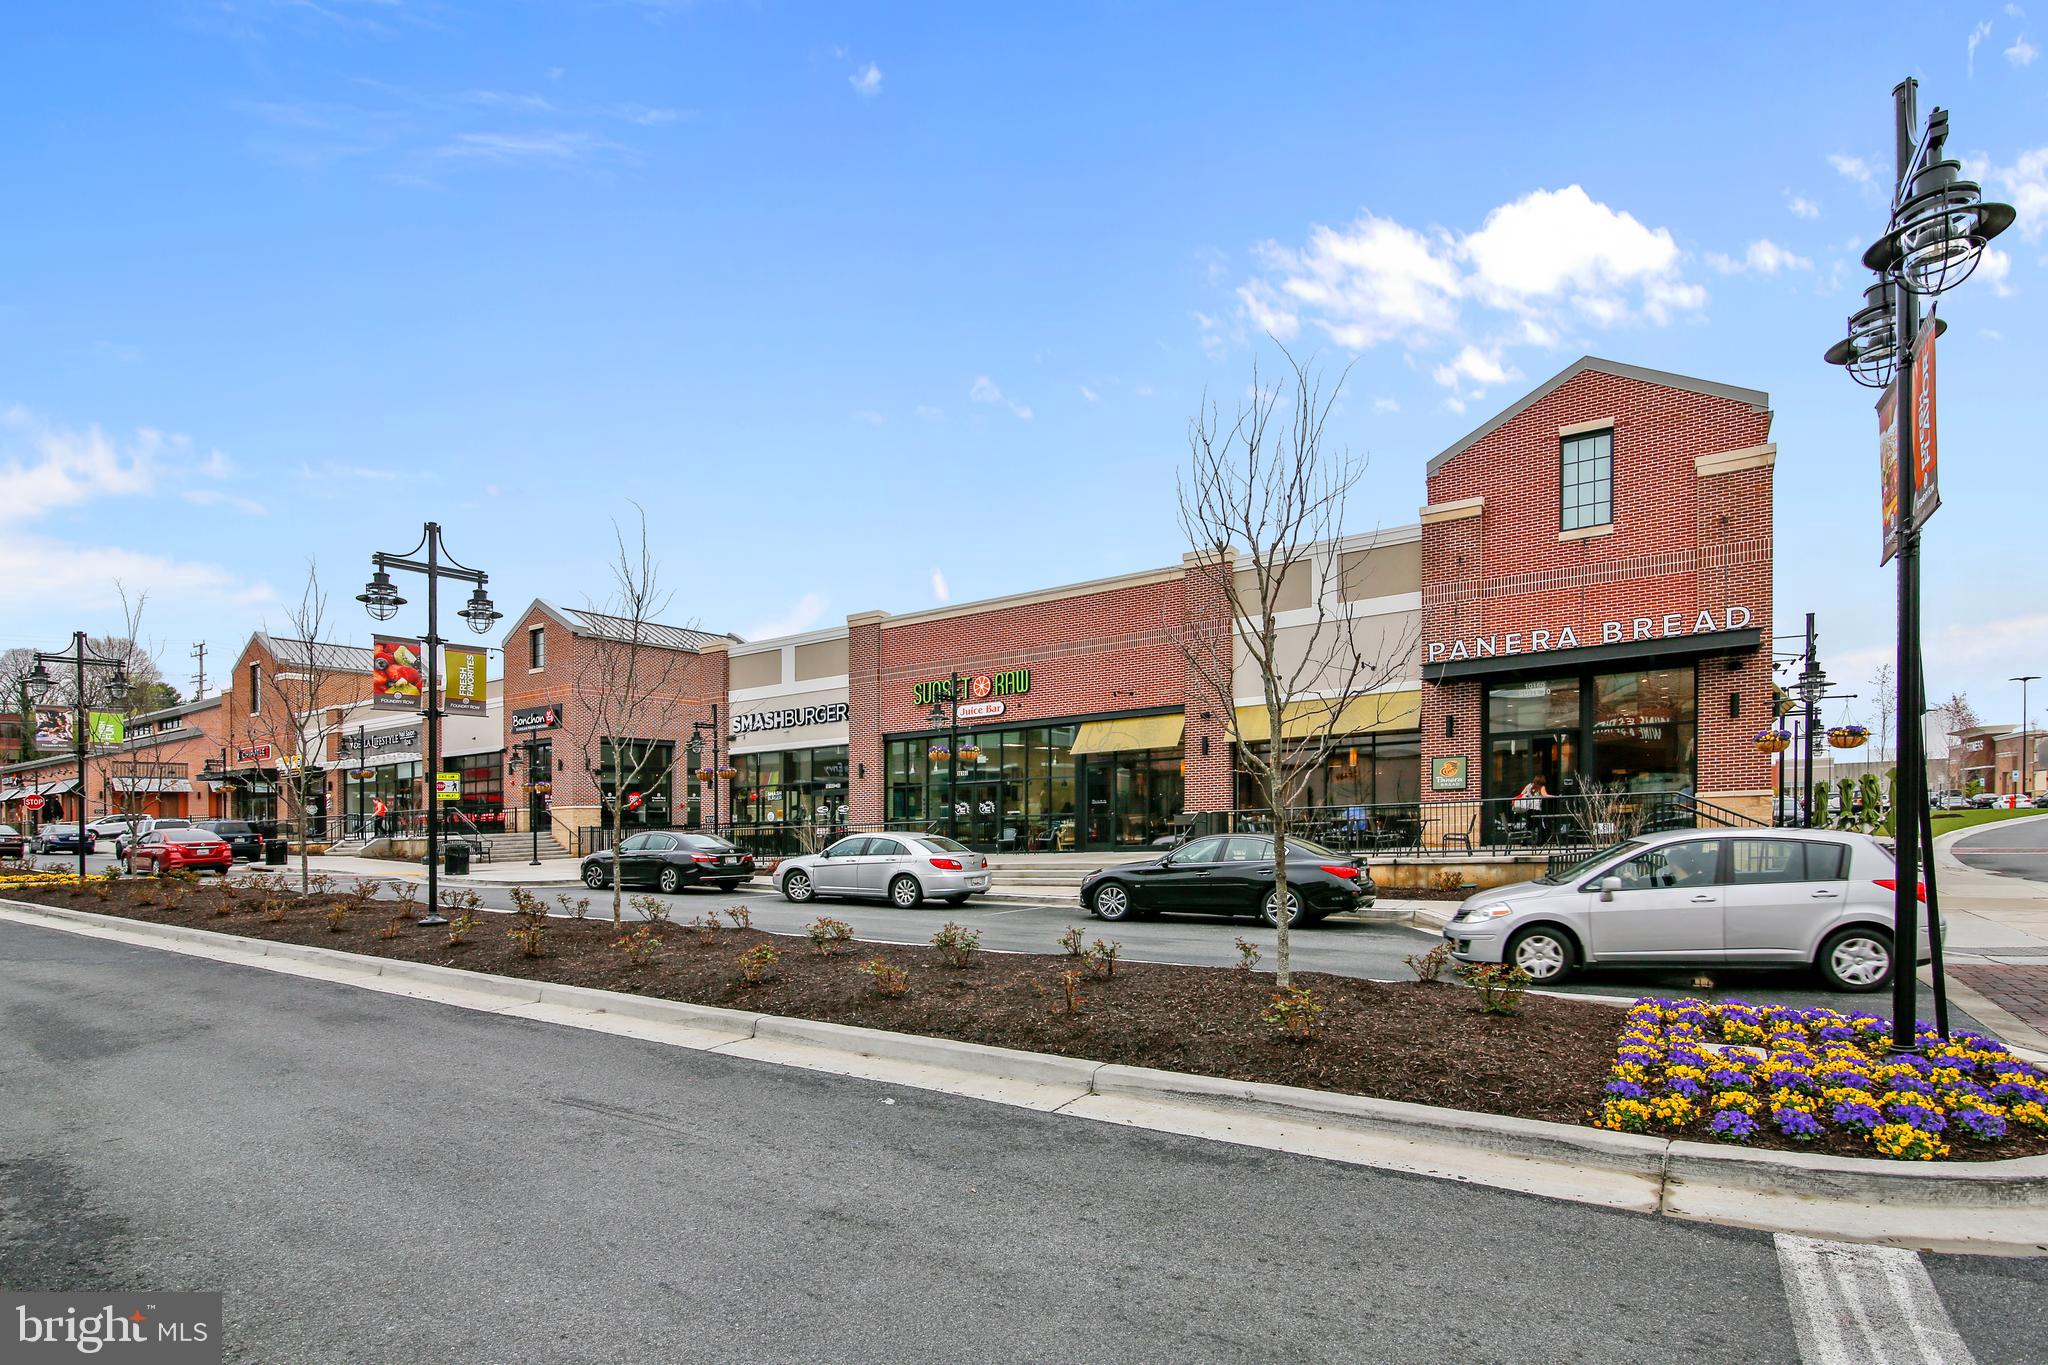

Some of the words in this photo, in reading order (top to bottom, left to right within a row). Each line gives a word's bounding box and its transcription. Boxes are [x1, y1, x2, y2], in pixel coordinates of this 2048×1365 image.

[1427, 626, 1579, 663] PANERA
[1602, 605, 1751, 645] BREAD
[459, 667, 467, 696] FRESH
[466, 654, 475, 697] FAVORITES
[995, 669, 1029, 696] RAW
[512, 712, 545, 727] Bonchon
[733, 702, 848, 733] SMASHBURGER
[960, 706, 983, 716] Juice
[986, 704, 1001, 713] Bar
